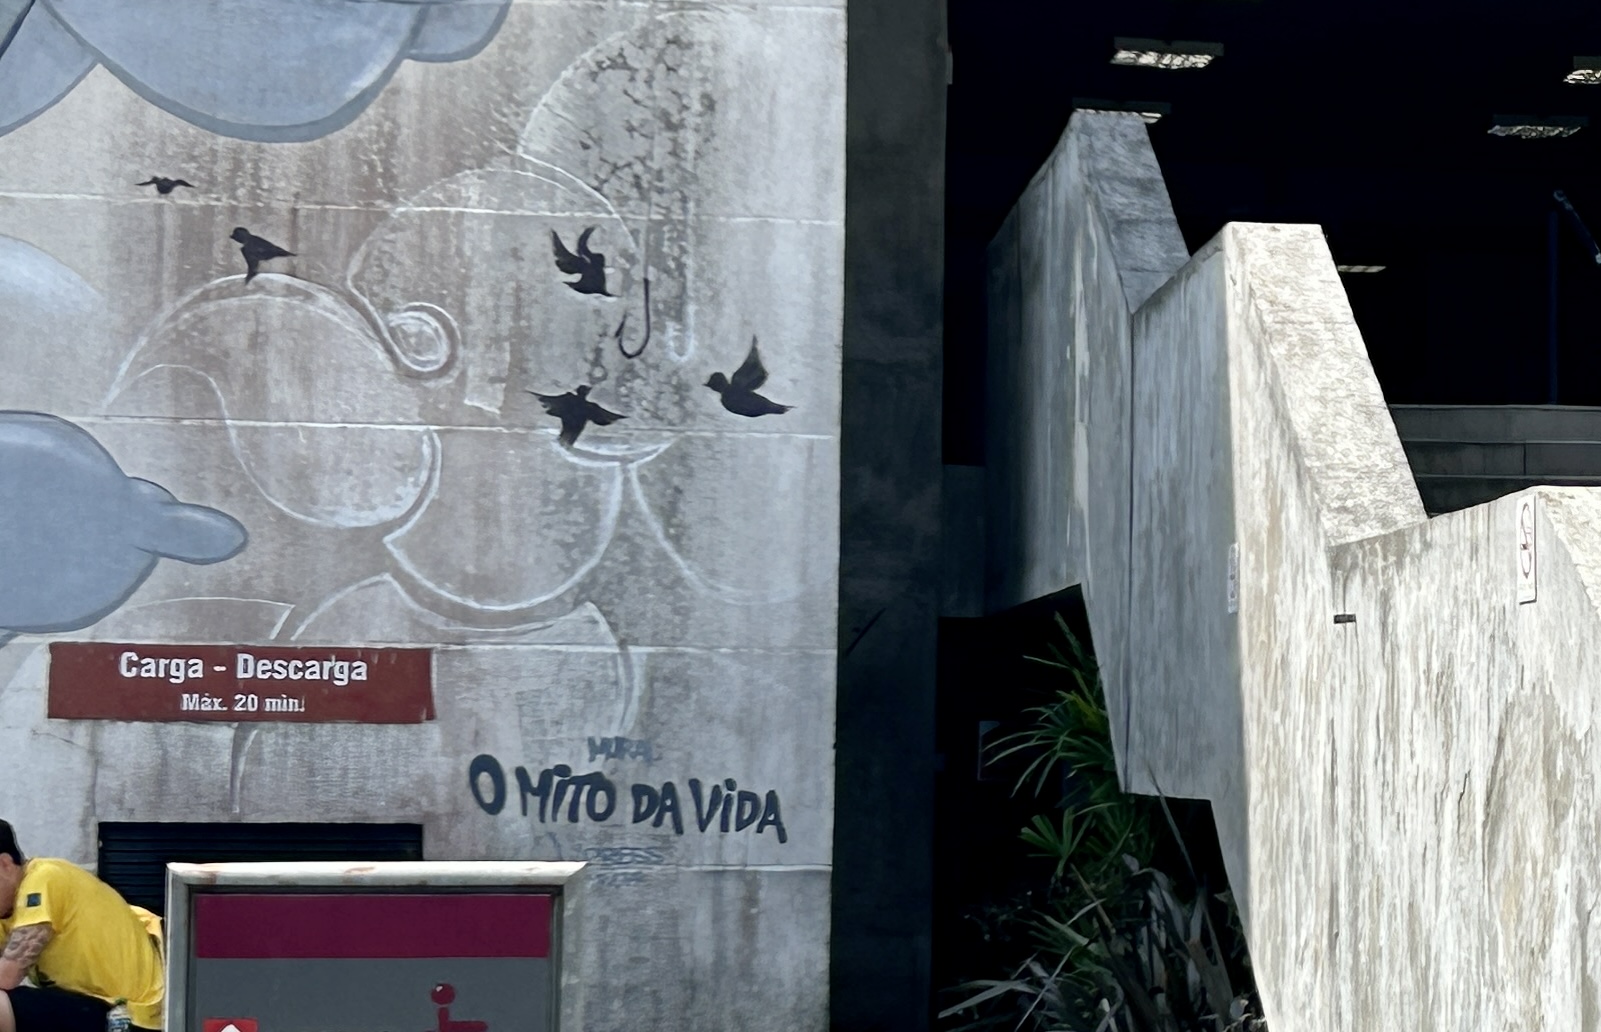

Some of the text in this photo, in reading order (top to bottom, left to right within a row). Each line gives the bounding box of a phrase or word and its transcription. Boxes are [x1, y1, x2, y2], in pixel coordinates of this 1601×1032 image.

[118, 651, 204, 684] Carga
[235, 652, 368, 686] Descarga
[233, 693, 259, 712] 20
[469, 753, 507, 816] O
[630, 780, 685, 835] DA
